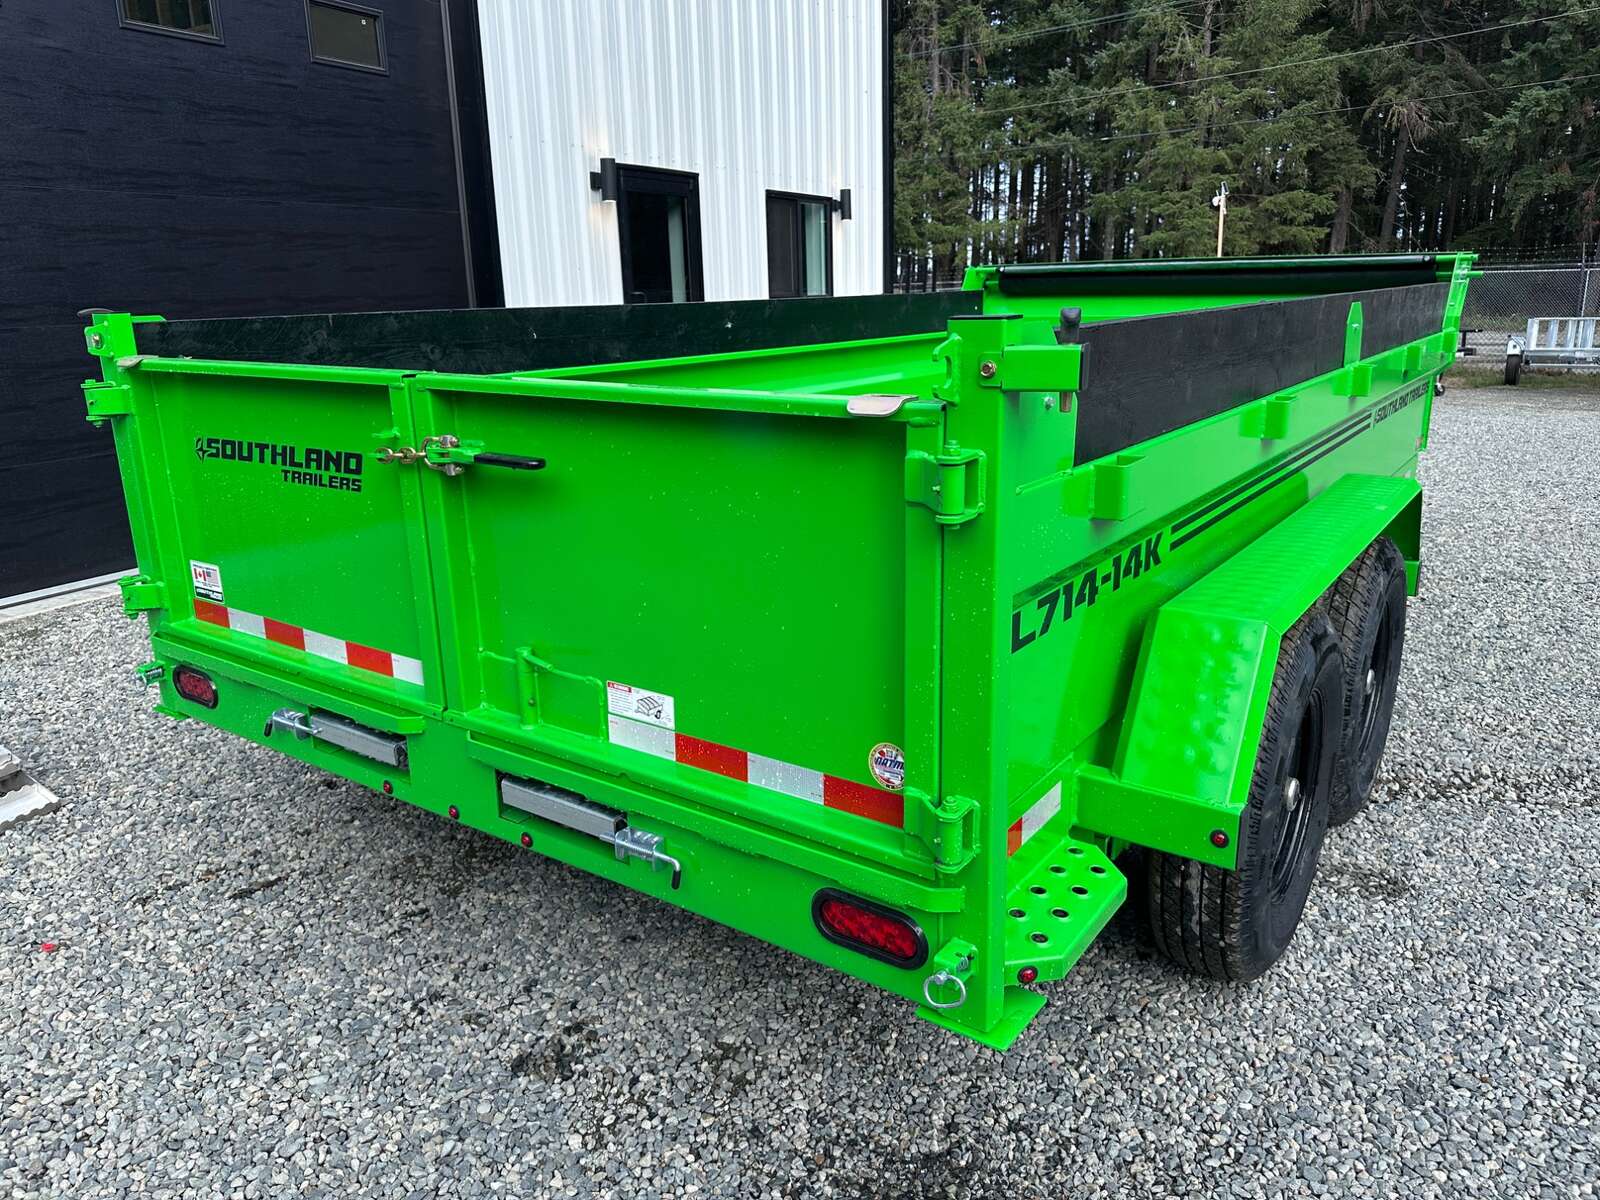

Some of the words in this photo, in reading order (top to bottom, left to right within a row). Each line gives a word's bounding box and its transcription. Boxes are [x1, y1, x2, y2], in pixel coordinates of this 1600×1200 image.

[206, 438, 363, 475] SOUTHLAND
[281, 469, 362, 492] TRAILERS
[1011, 531, 1163, 654] L714-14K
